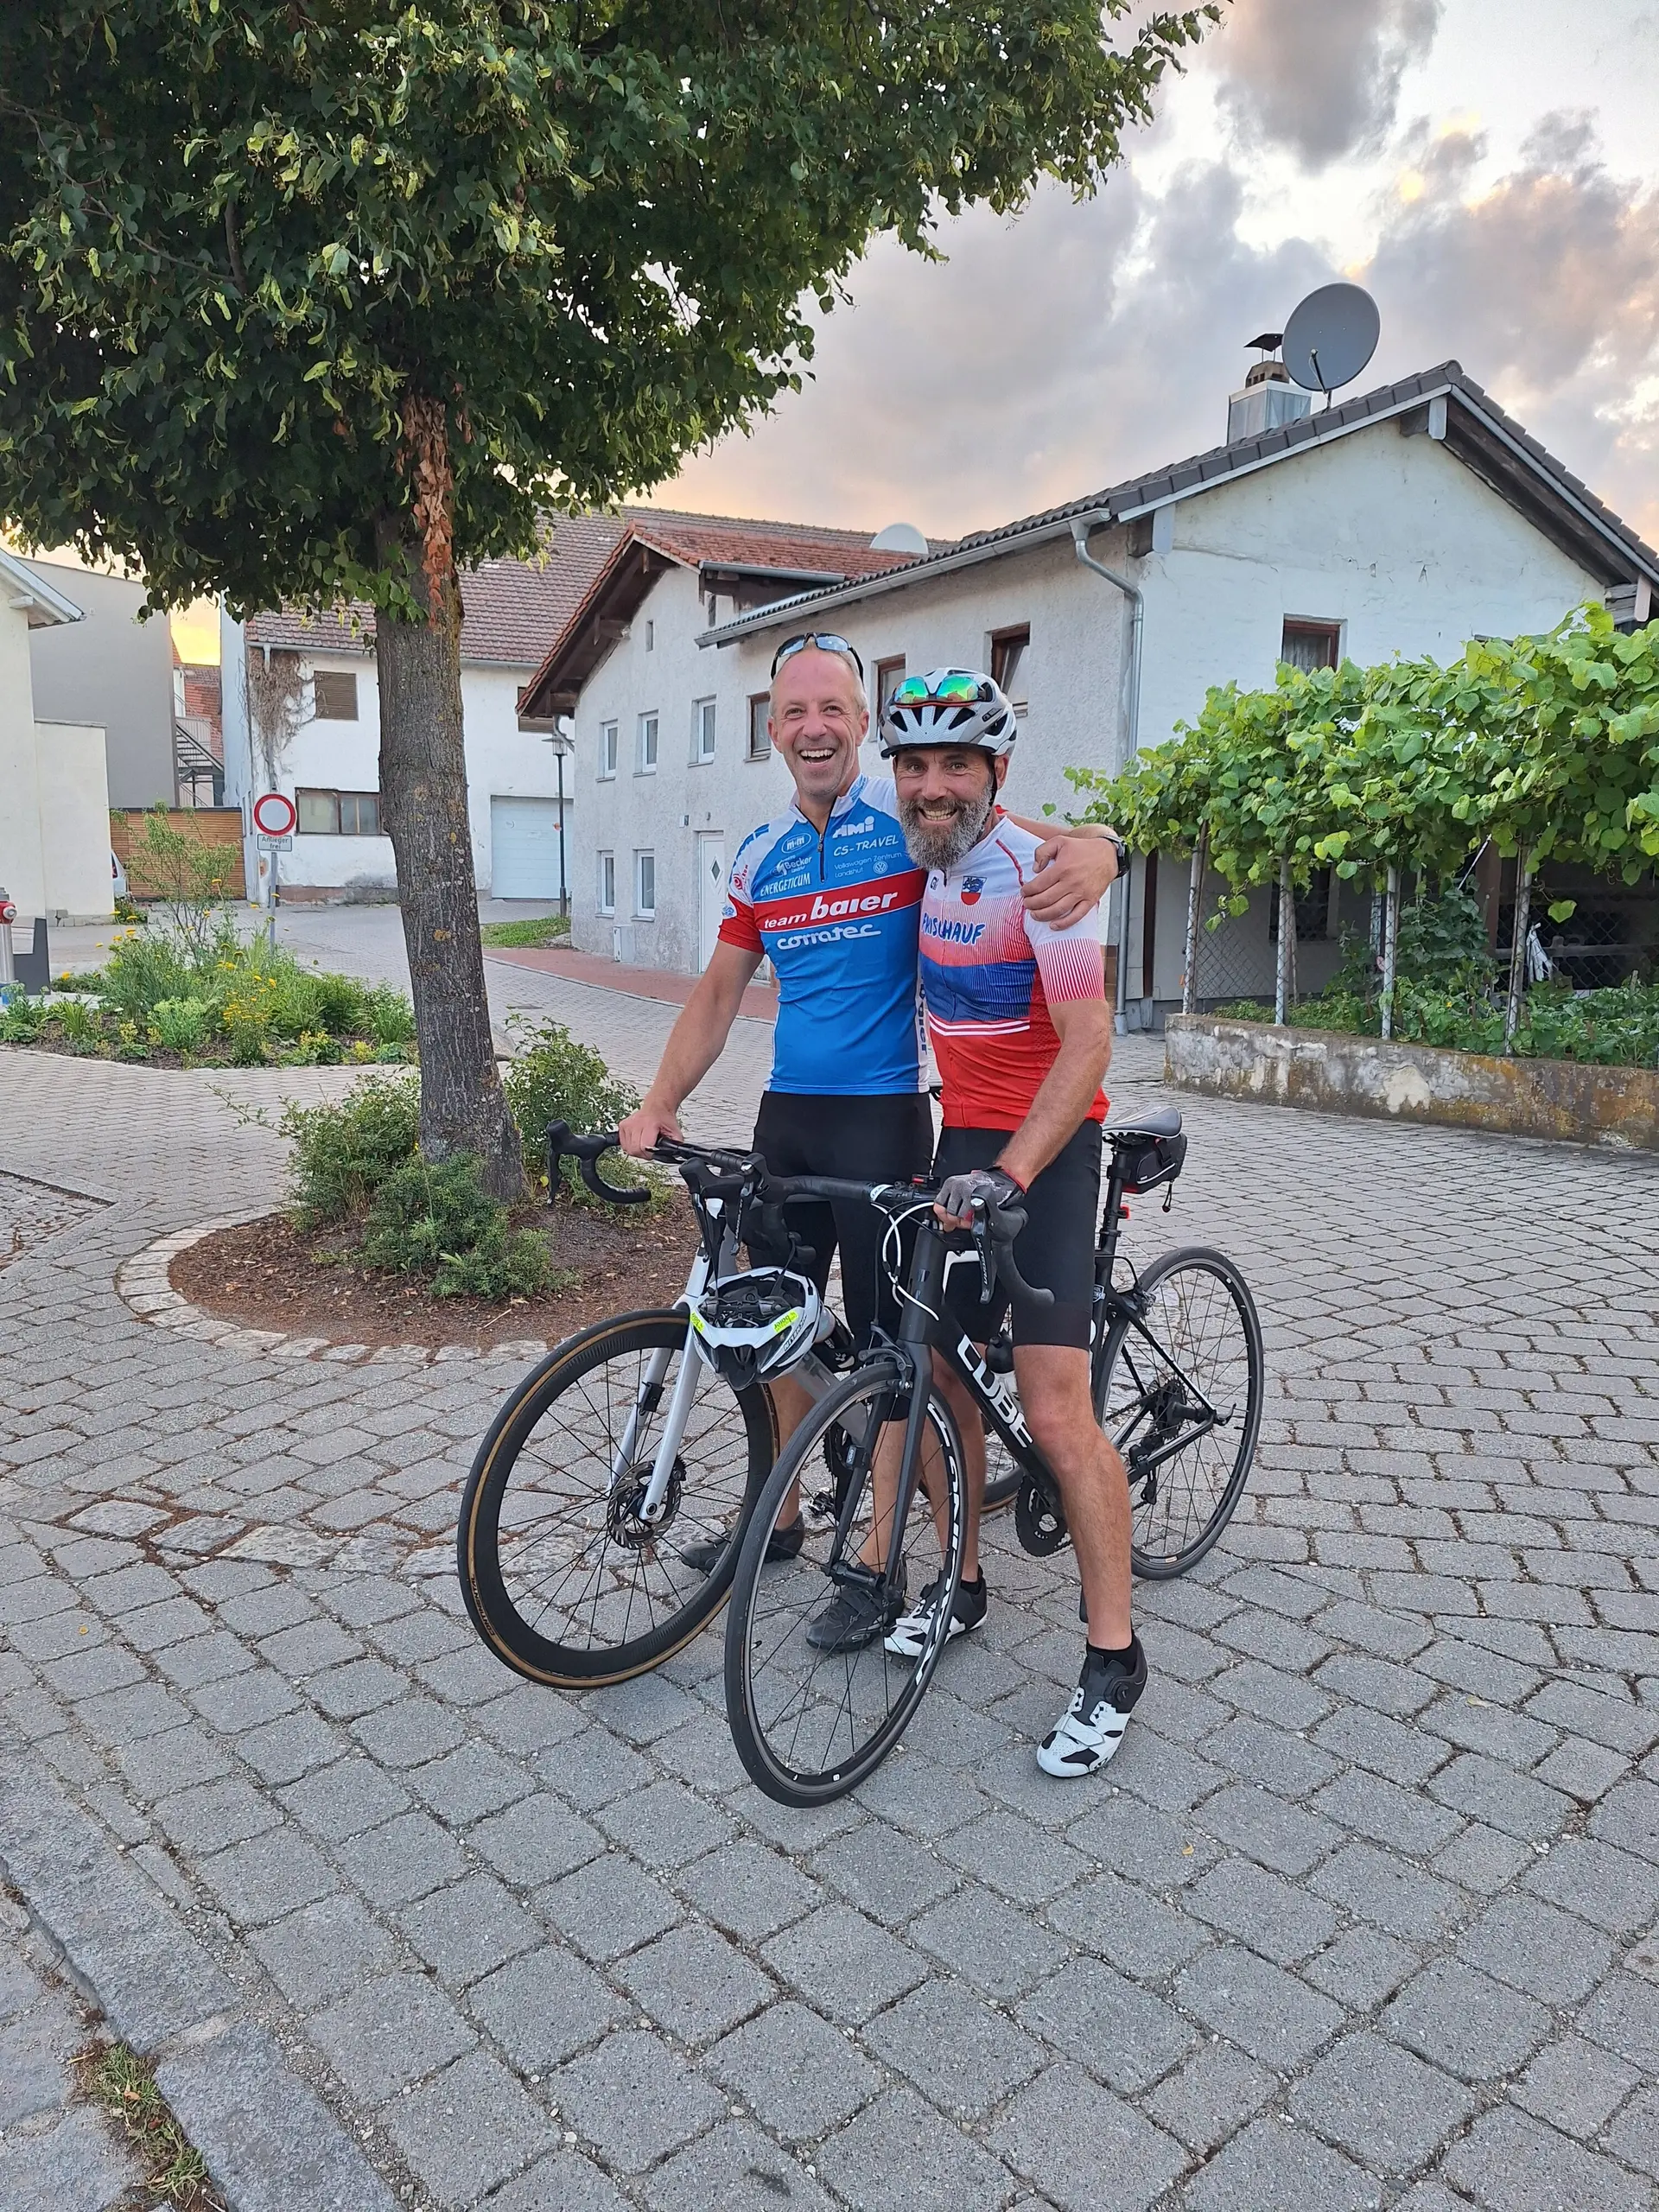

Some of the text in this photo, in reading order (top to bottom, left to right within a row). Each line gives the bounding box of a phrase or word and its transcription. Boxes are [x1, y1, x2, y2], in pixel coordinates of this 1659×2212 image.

[833, 835, 899, 856] CS-TRAVEL
[873, 852, 902, 863] Zentrum
[785, 856, 812, 869] Becker
[760, 872, 810, 896] ENERGETICUM
[764, 892, 898, 929] team baier
[957, 1333, 1033, 1448] CUBE
[470, 1573, 495, 1636] CONTINENTAL
